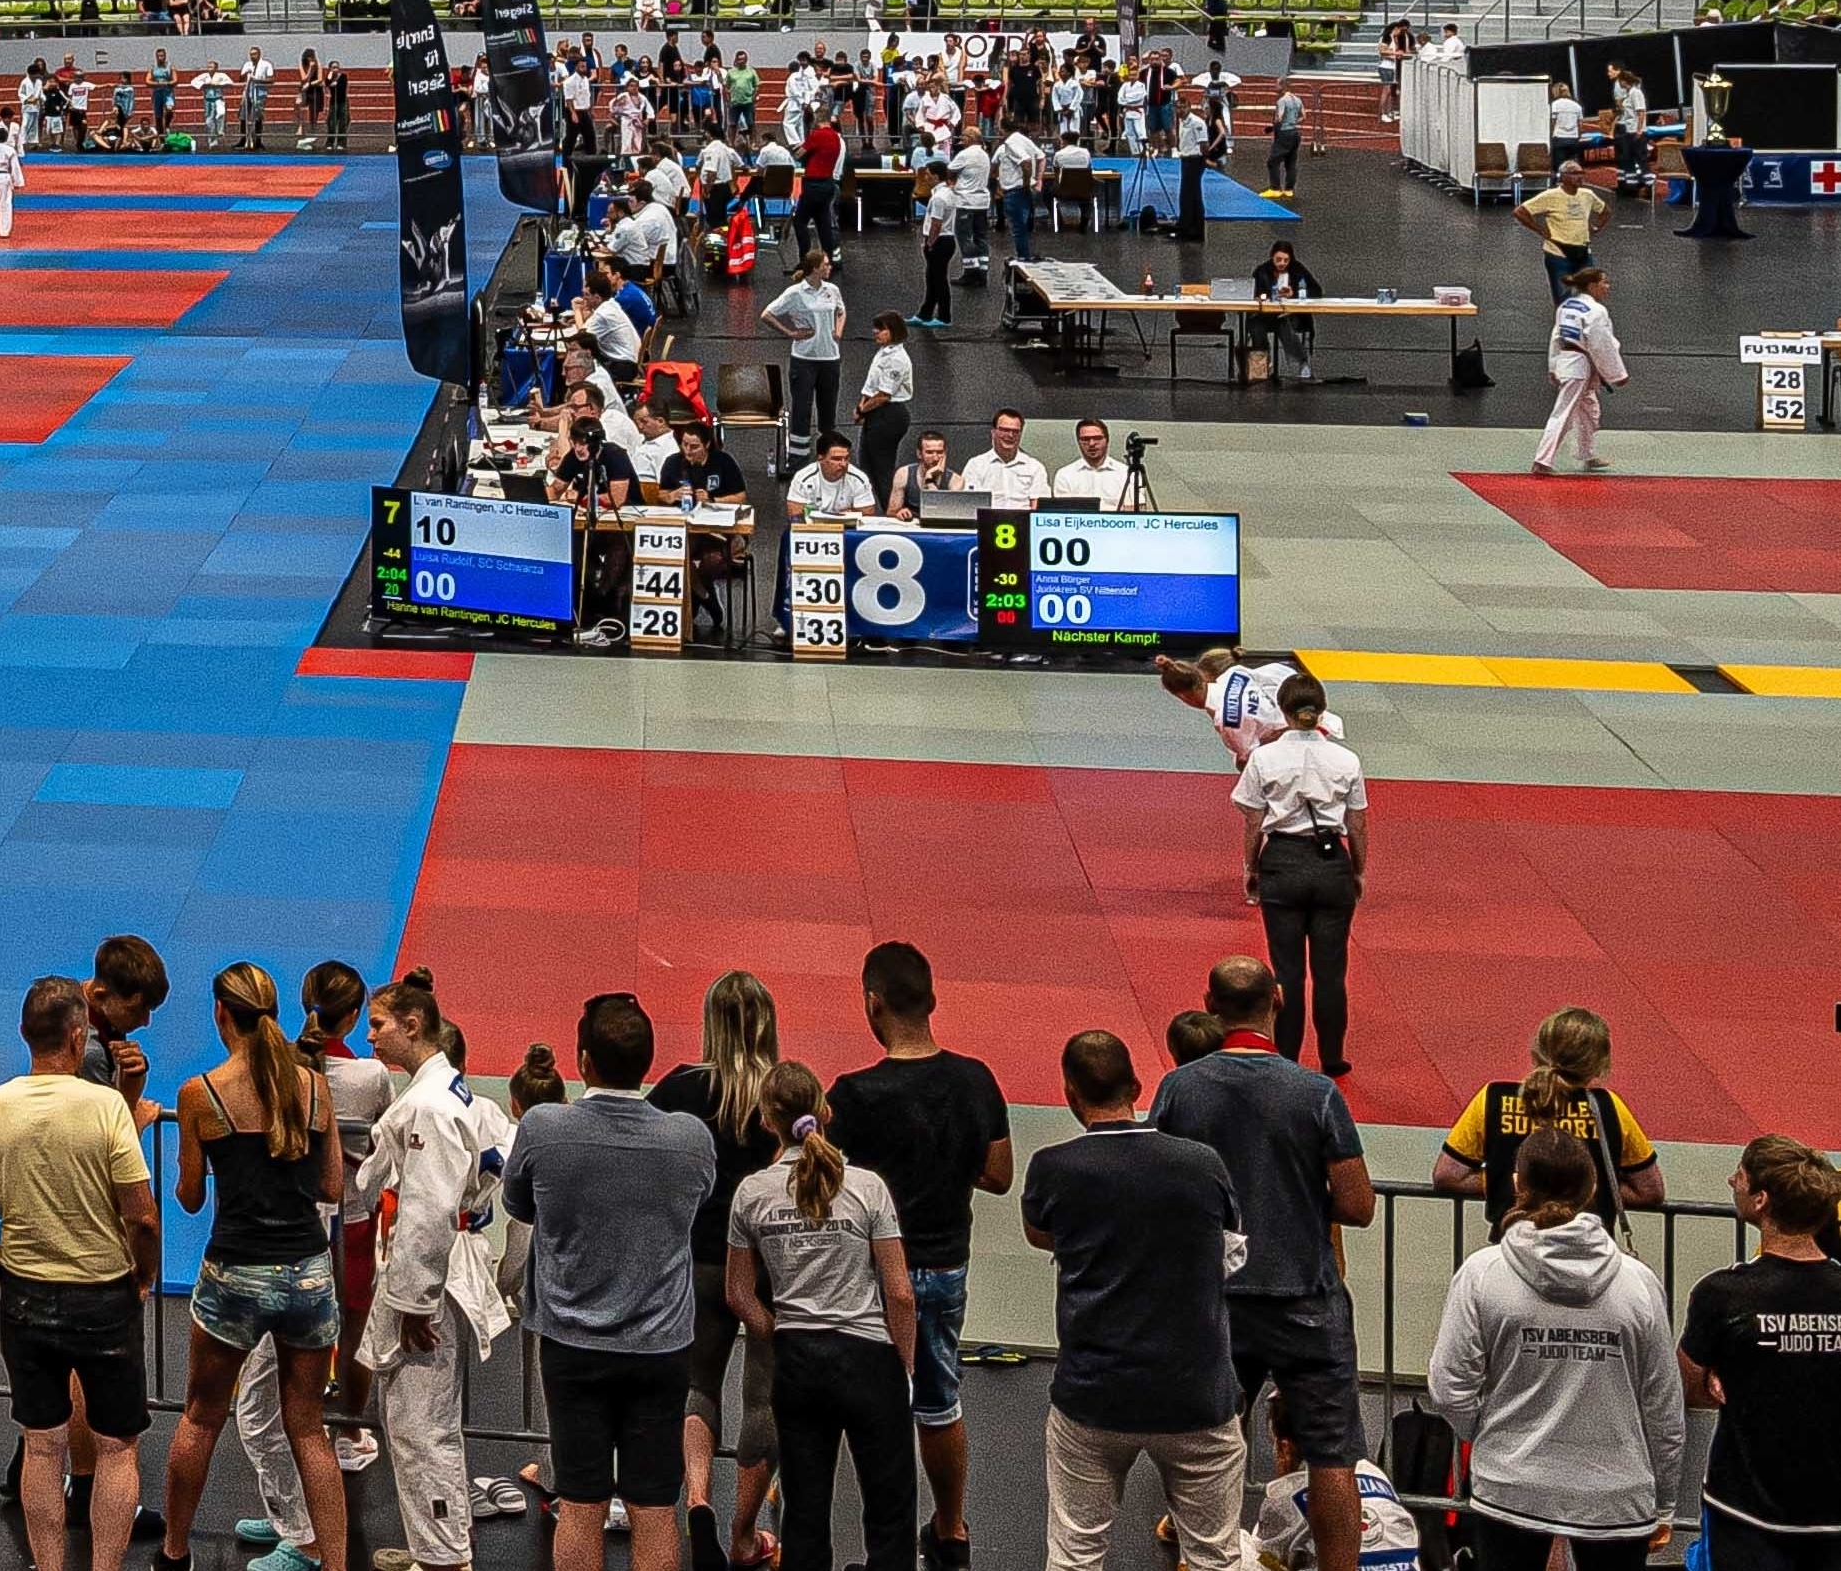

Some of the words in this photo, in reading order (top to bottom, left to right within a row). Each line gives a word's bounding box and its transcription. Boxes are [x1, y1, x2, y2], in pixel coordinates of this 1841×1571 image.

[1744, 345, 1763, 354] FU
[1765, 345, 1779, 354] 13
[1782, 345, 1804, 354] MU
[1806, 346, 1819, 355] 13
[1766, 371, 1801, 389] -28
[1767, 400, 1804, 419] -52
[383, 501, 400, 524] 7
[425, 499, 443, 507] van
[499, 503, 514, 515] JC
[516, 504, 560, 519] Hercules
[416, 516, 456, 546] 10
[1035, 516, 1060, 528] Lisa
[1064, 517, 1140, 531] Eijkenboom,
[1143, 519, 1160, 530] JC
[1164, 519, 1219, 530] Hercules
[639, 534, 663, 548] FU
[665, 535, 683, 549] 13
[995, 524, 1017, 549] 8
[383, 548, 401, 559] -44
[795, 542, 819, 556] FU
[821, 542, 841, 556] 13
[1039, 537, 1091, 566] 00
[377, 566, 407, 580] 2:04
[851, 533, 926, 625] 8
[993, 573, 1017, 585] -30
[1035, 574, 1060, 584] Anna
[384, 583, 399, 595] 20
[416, 571, 456, 601] 00
[636, 572, 682, 598] -44
[795, 579, 842, 605] -30
[1080, 585, 1093, 594] SV
[986, 593, 1026, 608] 2:03
[1039, 594, 1092, 624] 00
[421, 606, 438, 616] van
[496, 613, 509, 625] JC
[512, 614, 557, 630] Hercules
[633, 610, 679, 636] -28
[796, 618, 845, 646] -33
[1052, 629, 1110, 643] Nächster
[1115, 632, 1161, 646] Kampf:
[1757, 1314, 1786, 1333] TSV
[1522, 1329, 1544, 1343] TSV
[1777, 1335, 1813, 1352] JUDO
[1538, 1346, 1569, 1360] JUDO
[1572, 1347, 1606, 1362] TEAM
